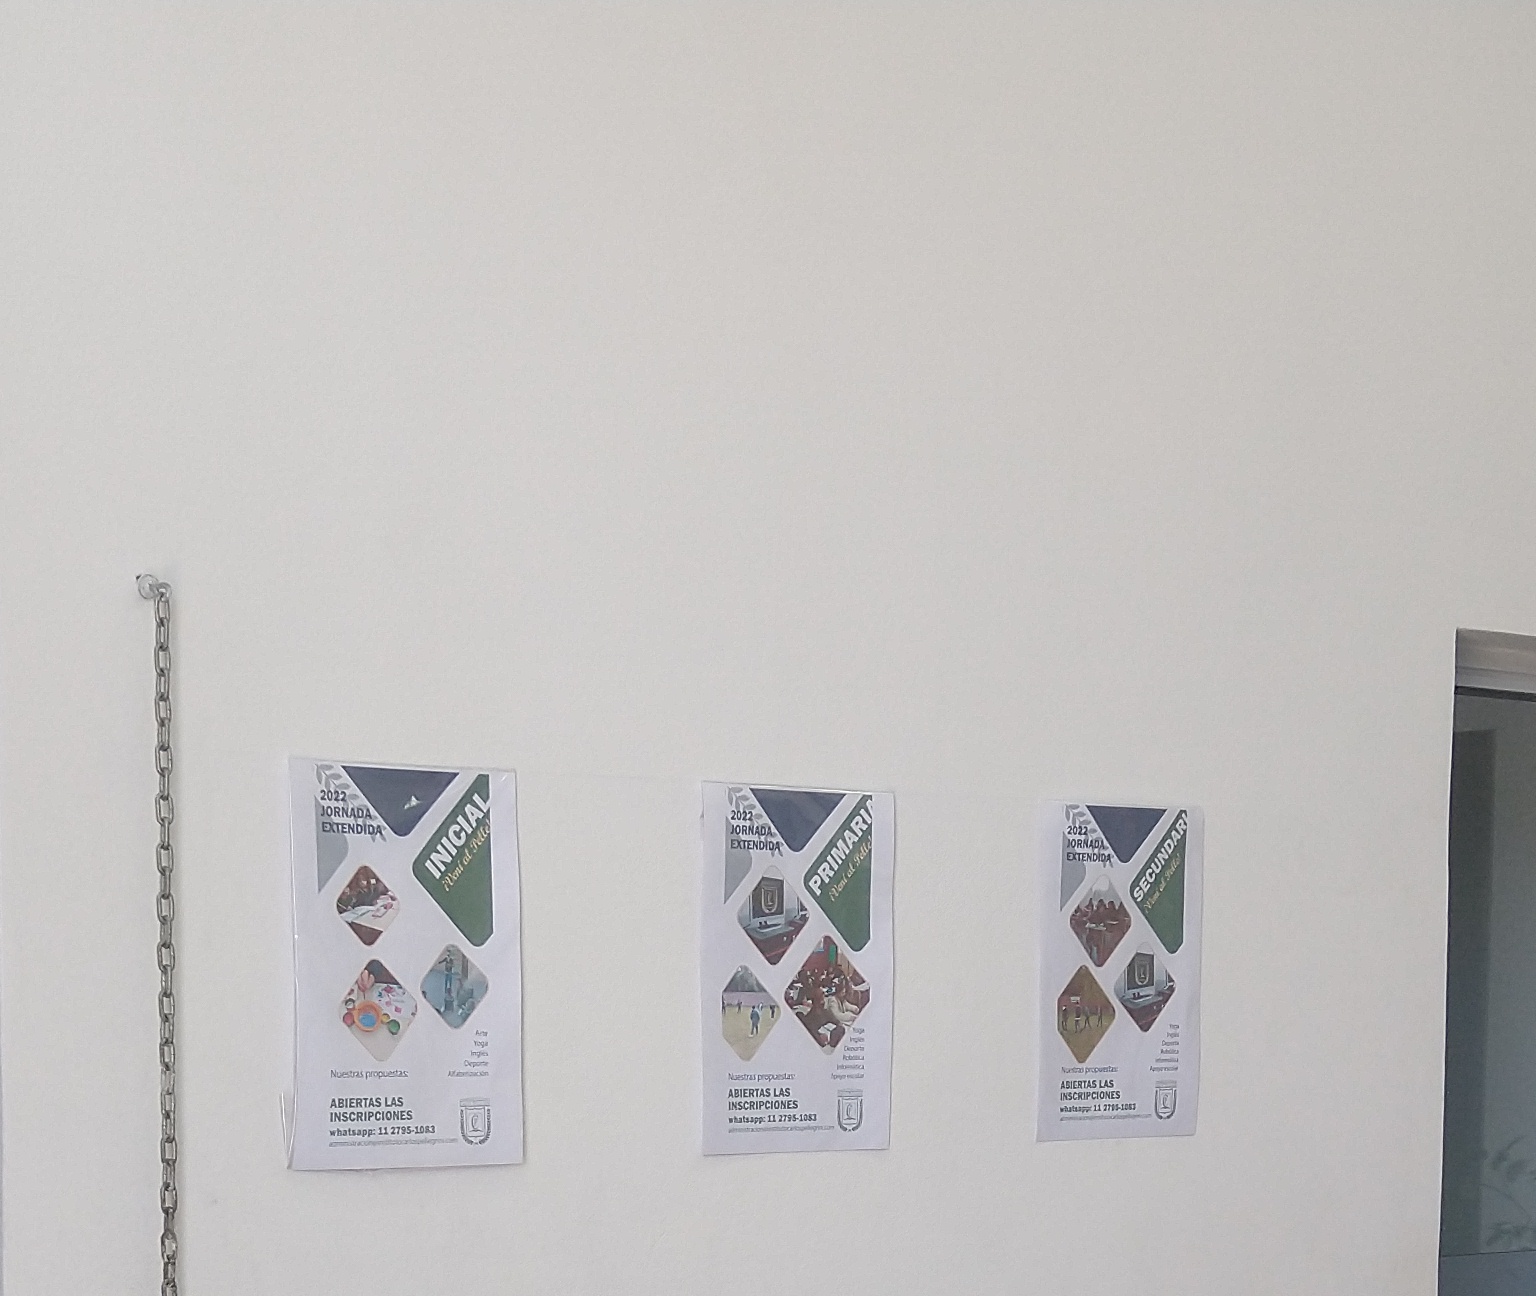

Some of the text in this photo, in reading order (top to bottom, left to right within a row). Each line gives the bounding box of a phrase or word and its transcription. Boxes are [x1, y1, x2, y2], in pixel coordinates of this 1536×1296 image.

[320, 790, 347, 801] 2022
[320, 805, 373, 820] JORNADA
[730, 810, 754, 821] 2022
[321, 821, 384, 836] EXTENDIDA
[730, 824, 773, 836] JORNADA
[1066, 825, 1088, 836] 2022
[425, 793, 491, 880] INICIAL
[730, 839, 781, 851] EXTENDIDA
[1066, 838, 1105, 850] JORNADA
[1066, 852, 1112, 863] EXTENDIDA
[1060, 1079, 1115, 1090] ABIERTAS LAS
[728, 1087, 791, 1098] ABIERTAS LAS
[1060, 1090, 1121, 1101] INSCRIPCIONES
[329, 1096, 404, 1108] ABIERTAS LAS
[728, 1100, 799, 1111] INSCRIPCIONES
[329, 1110, 413, 1122] INSCRIPCIONES
[378, 1126, 389, 1135] 11
